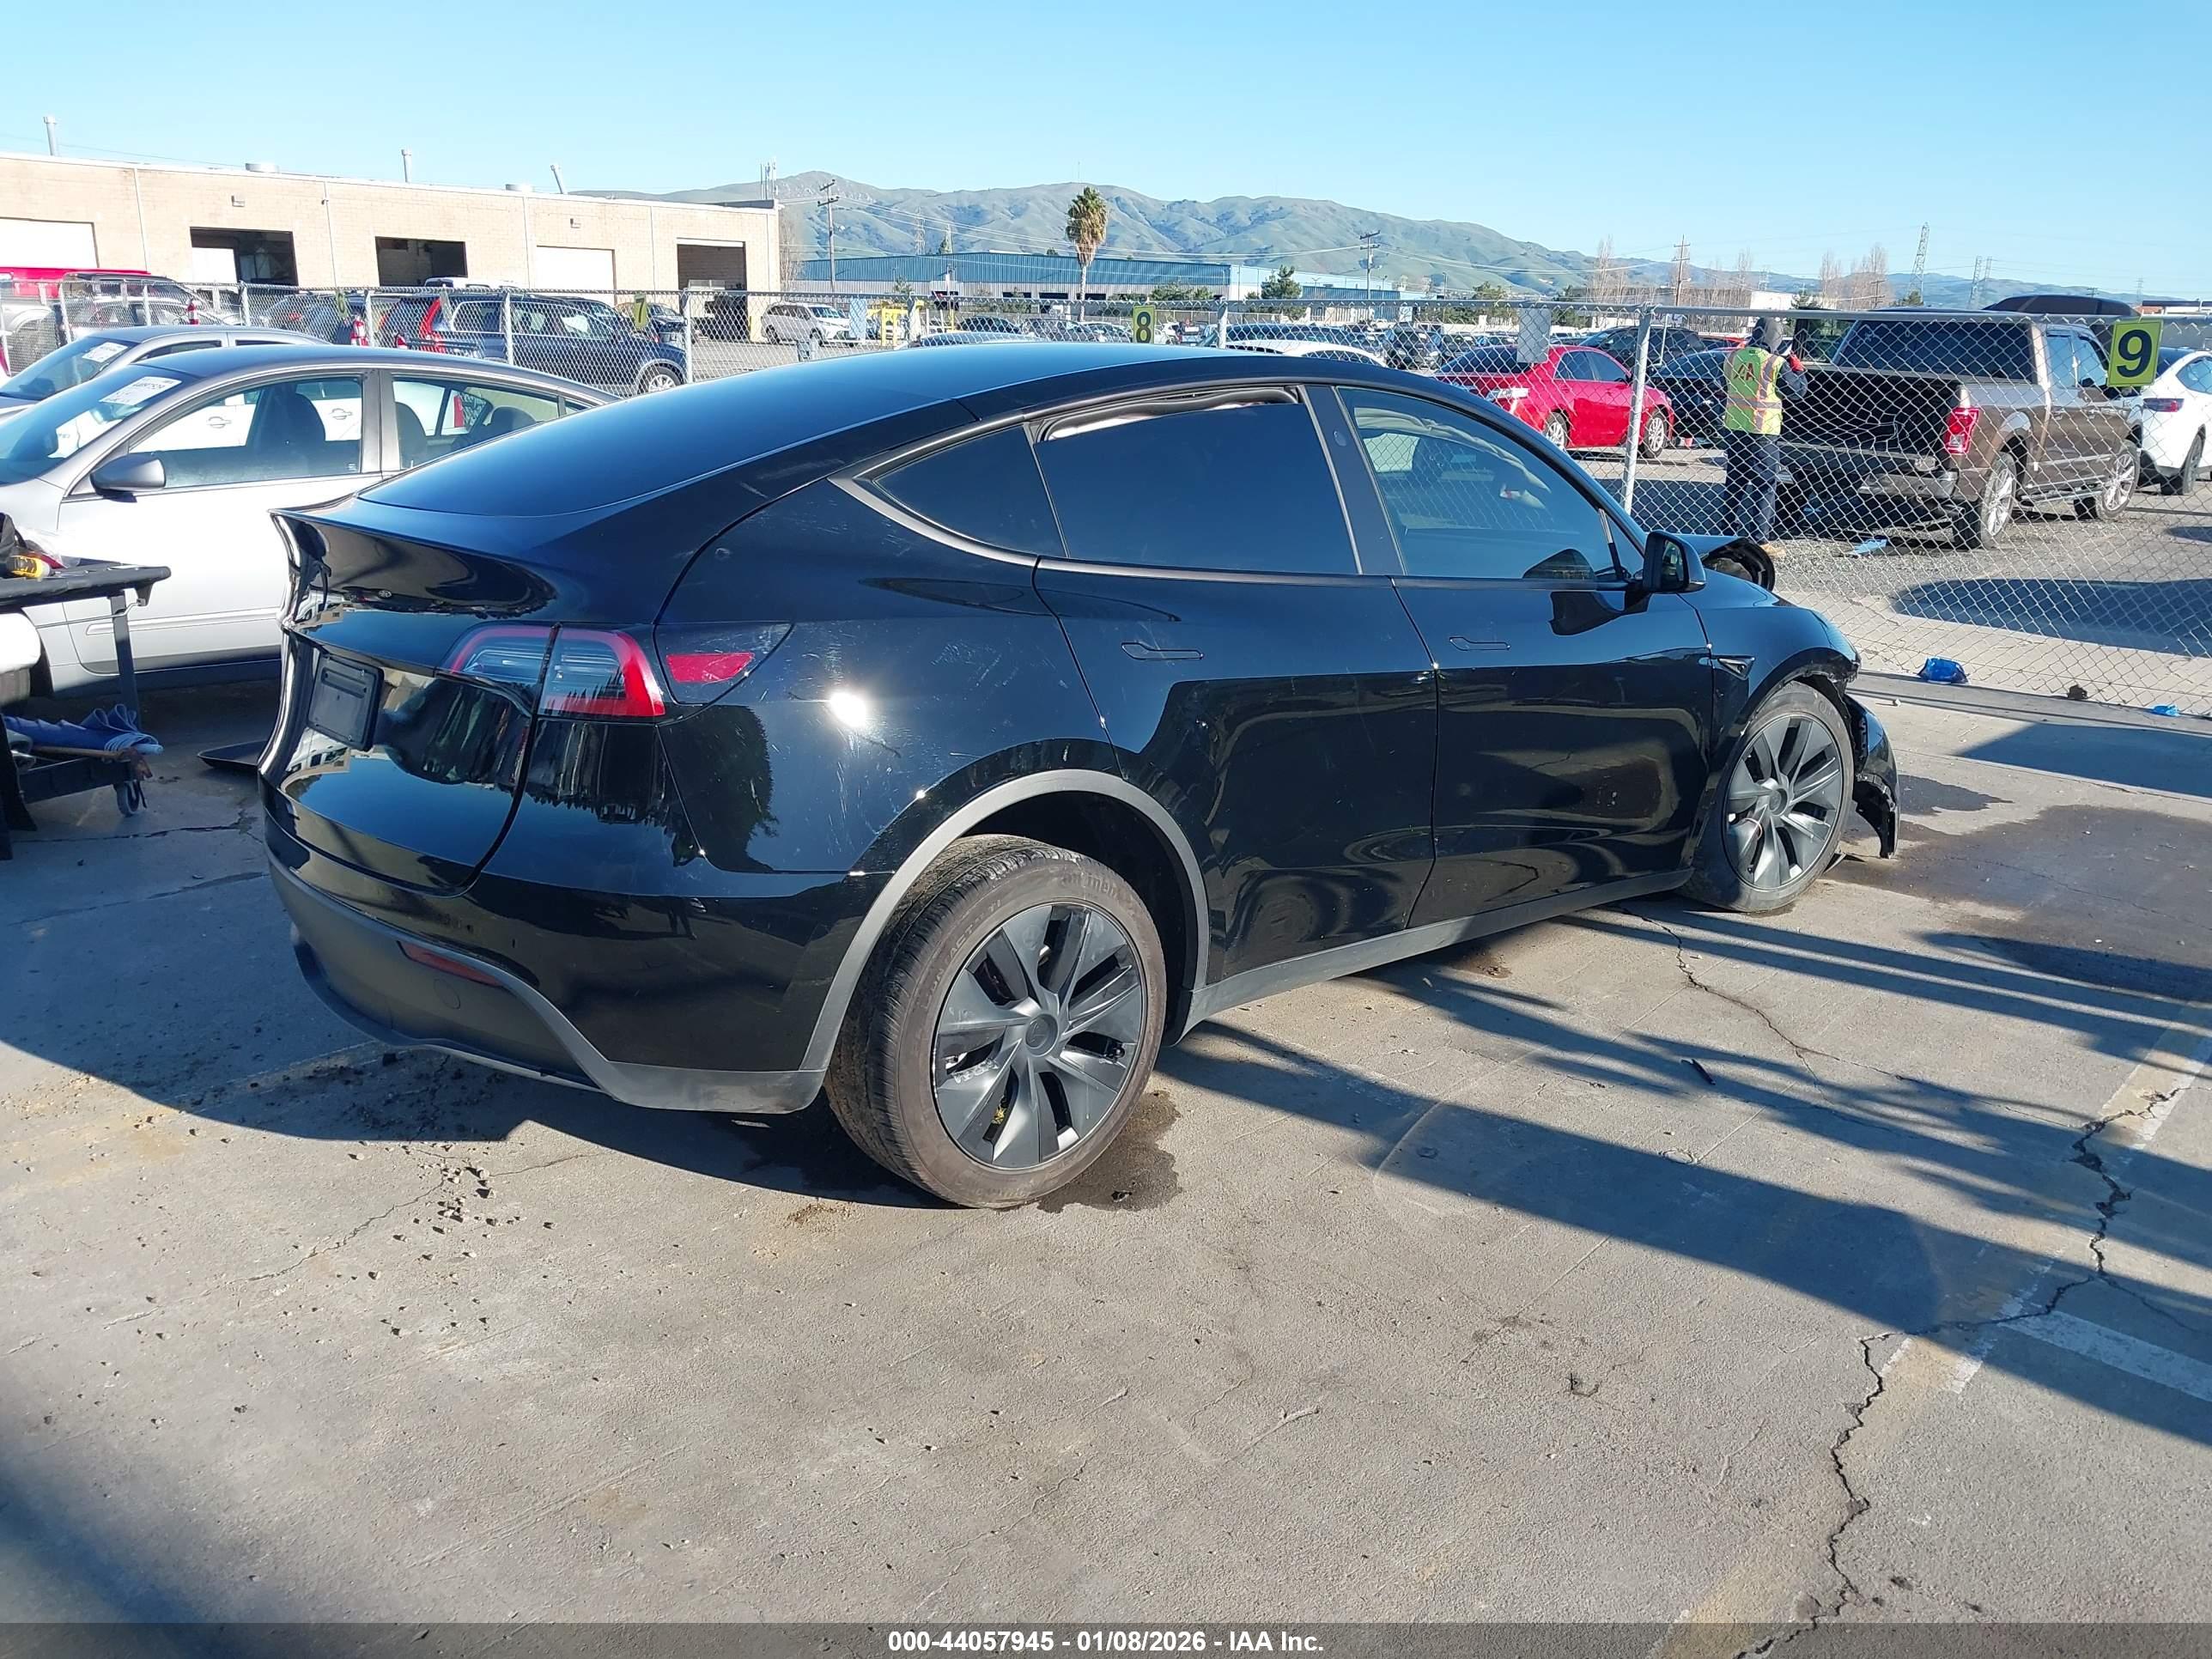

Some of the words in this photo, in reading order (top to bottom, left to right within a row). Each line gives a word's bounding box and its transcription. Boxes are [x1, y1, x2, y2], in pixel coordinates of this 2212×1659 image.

[635, 298, 644, 324] 7
[1136, 311, 1152, 343] 8
[2116, 329, 2153, 378] 9
